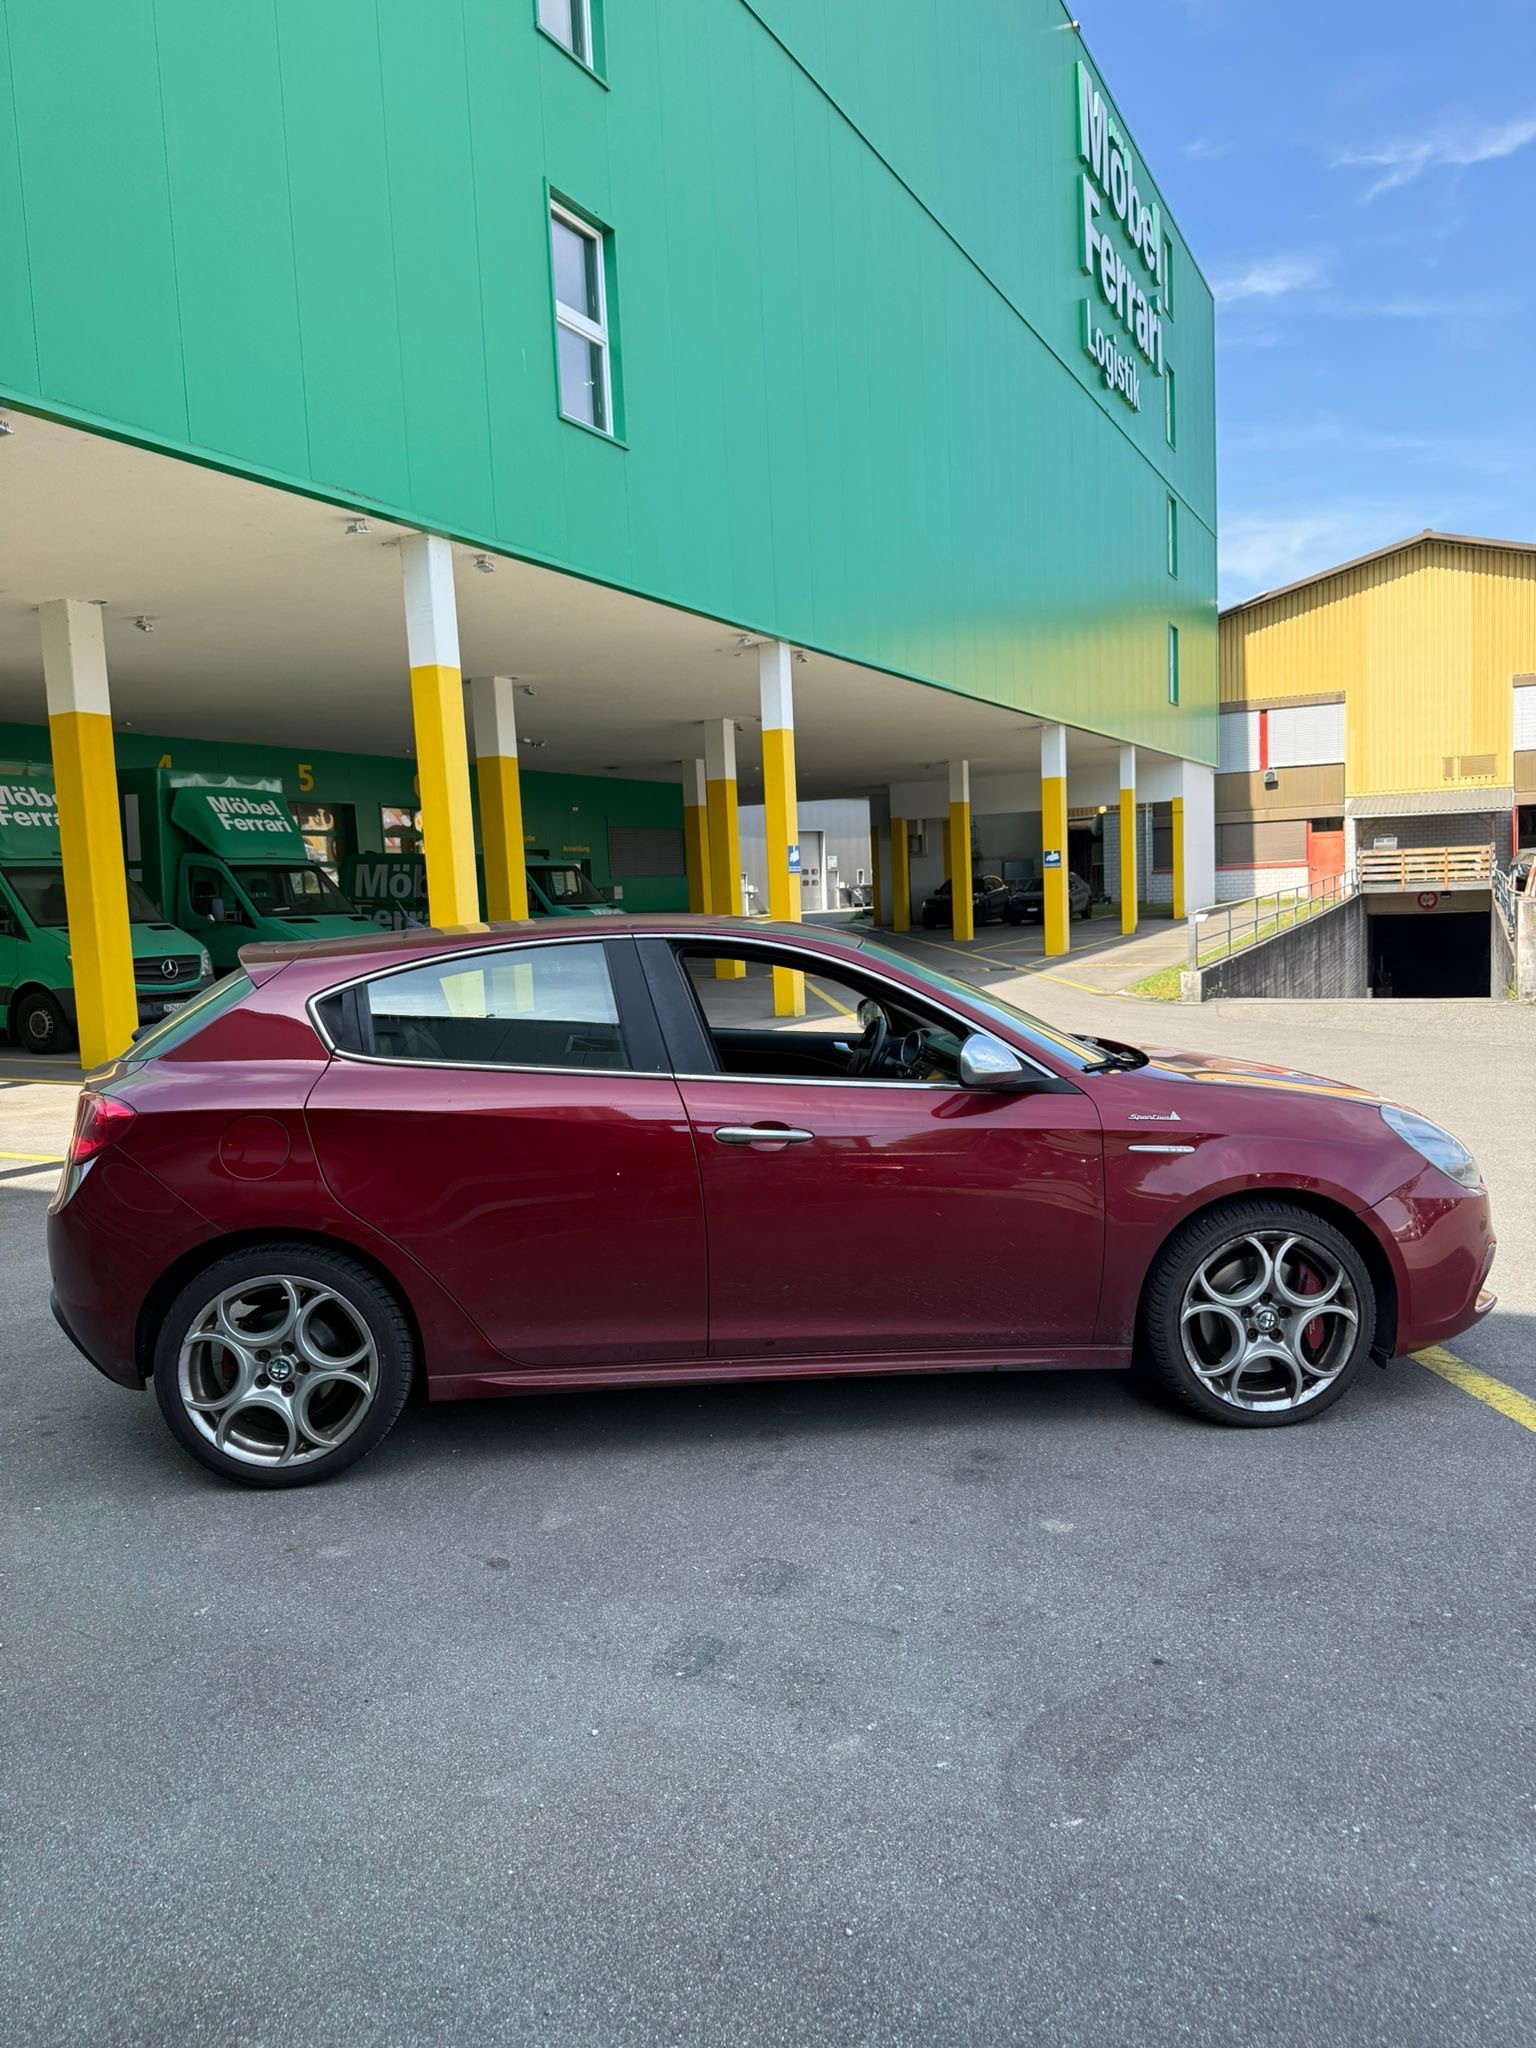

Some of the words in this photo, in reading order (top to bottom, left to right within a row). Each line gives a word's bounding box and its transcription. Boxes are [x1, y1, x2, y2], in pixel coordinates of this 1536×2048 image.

[1076, 61, 1161, 286] Möbel
[1081, 172, 1163, 377] Ferrari
[1084, 298, 1141, 413] Logistik
[298, 764, 314, 792] 5
[0, 785, 57, 807] Möb
[206, 796, 282, 816] Möbel
[0, 806, 60, 827] Ferr
[217, 814, 293, 833] Ferrari
[355, 864, 427, 898] Möb
